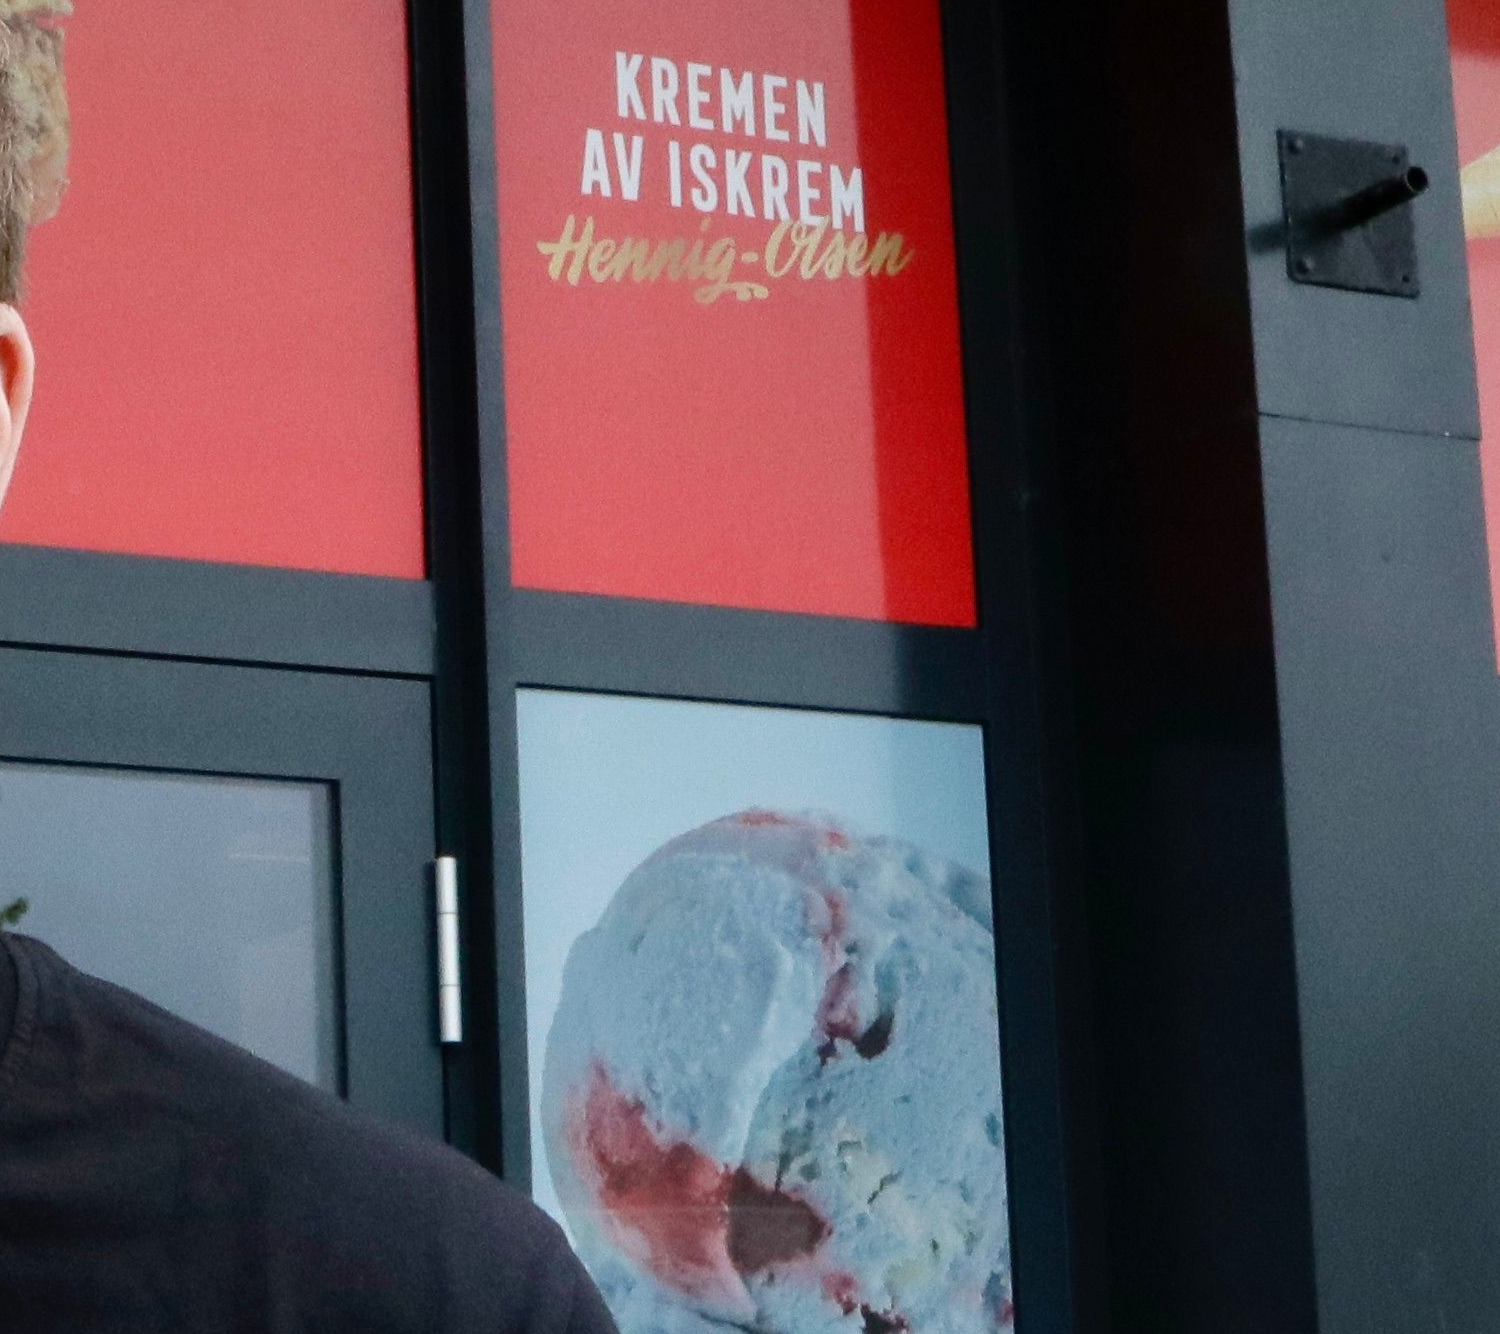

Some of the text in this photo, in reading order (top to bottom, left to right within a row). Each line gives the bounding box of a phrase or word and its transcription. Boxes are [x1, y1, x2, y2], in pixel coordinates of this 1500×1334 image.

[615, 51, 827, 148] KREMEN
[580, 128, 866, 233] AV ISKREM
